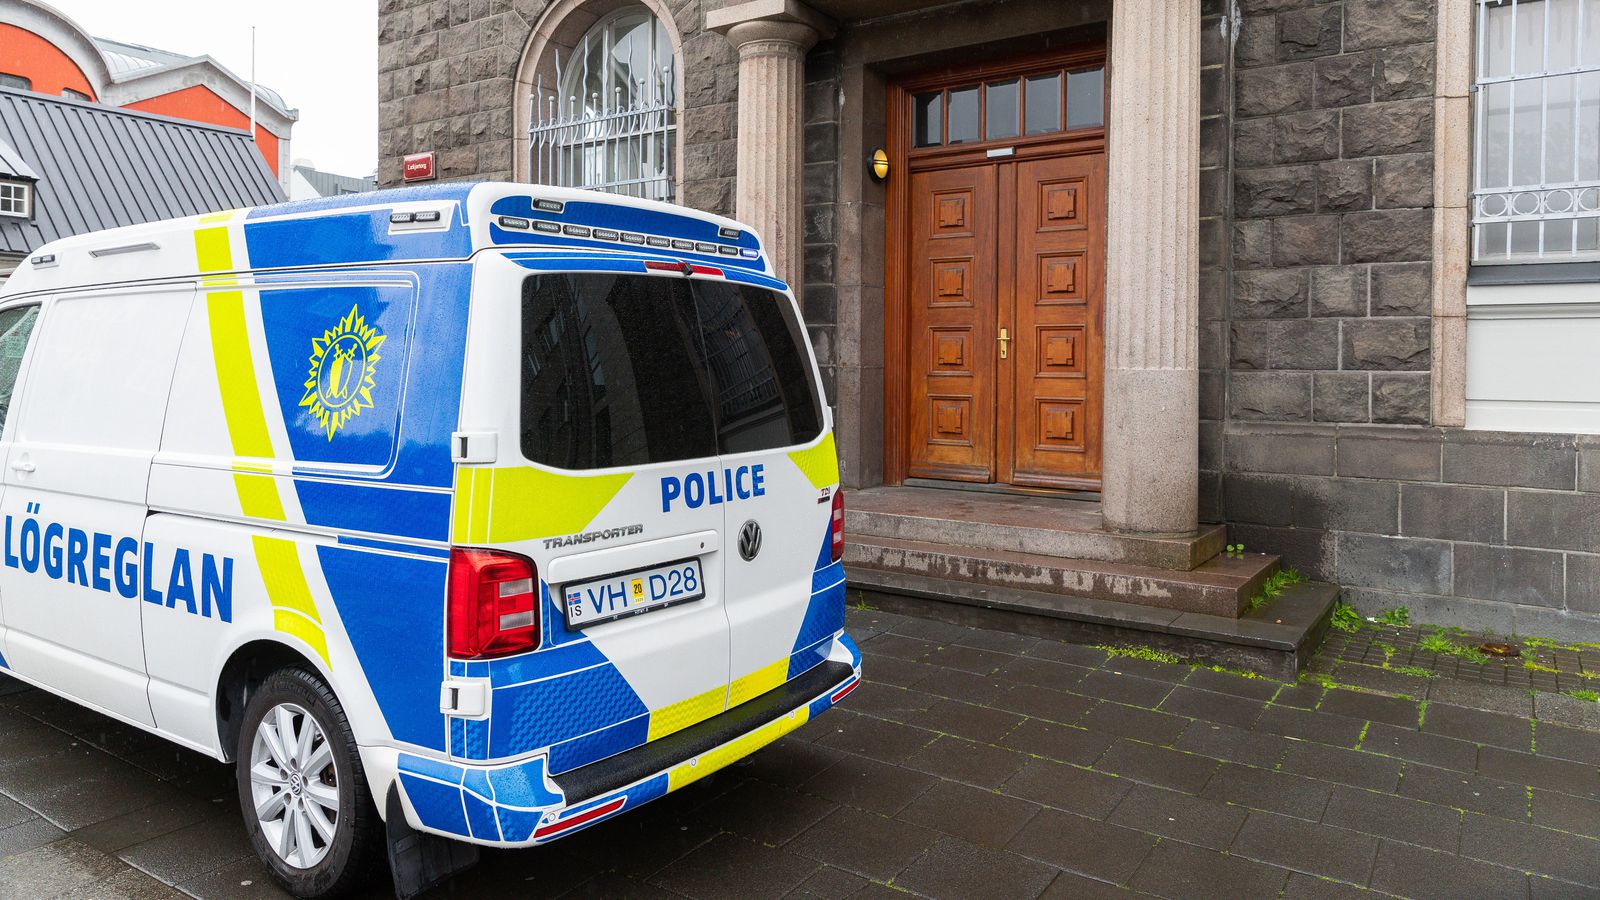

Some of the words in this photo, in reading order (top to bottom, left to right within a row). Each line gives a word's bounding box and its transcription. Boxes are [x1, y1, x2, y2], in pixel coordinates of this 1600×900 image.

[660, 463, 766, 513] POLICE
[542, 523, 644, 550] TRANSPORTER
[4, 501, 234, 624] LÖGREGLAN
[570, 605, 582, 618] IS
[587, 581, 628, 614] VH
[633, 583, 642, 594] 20
[649, 567, 697, 601] D28
